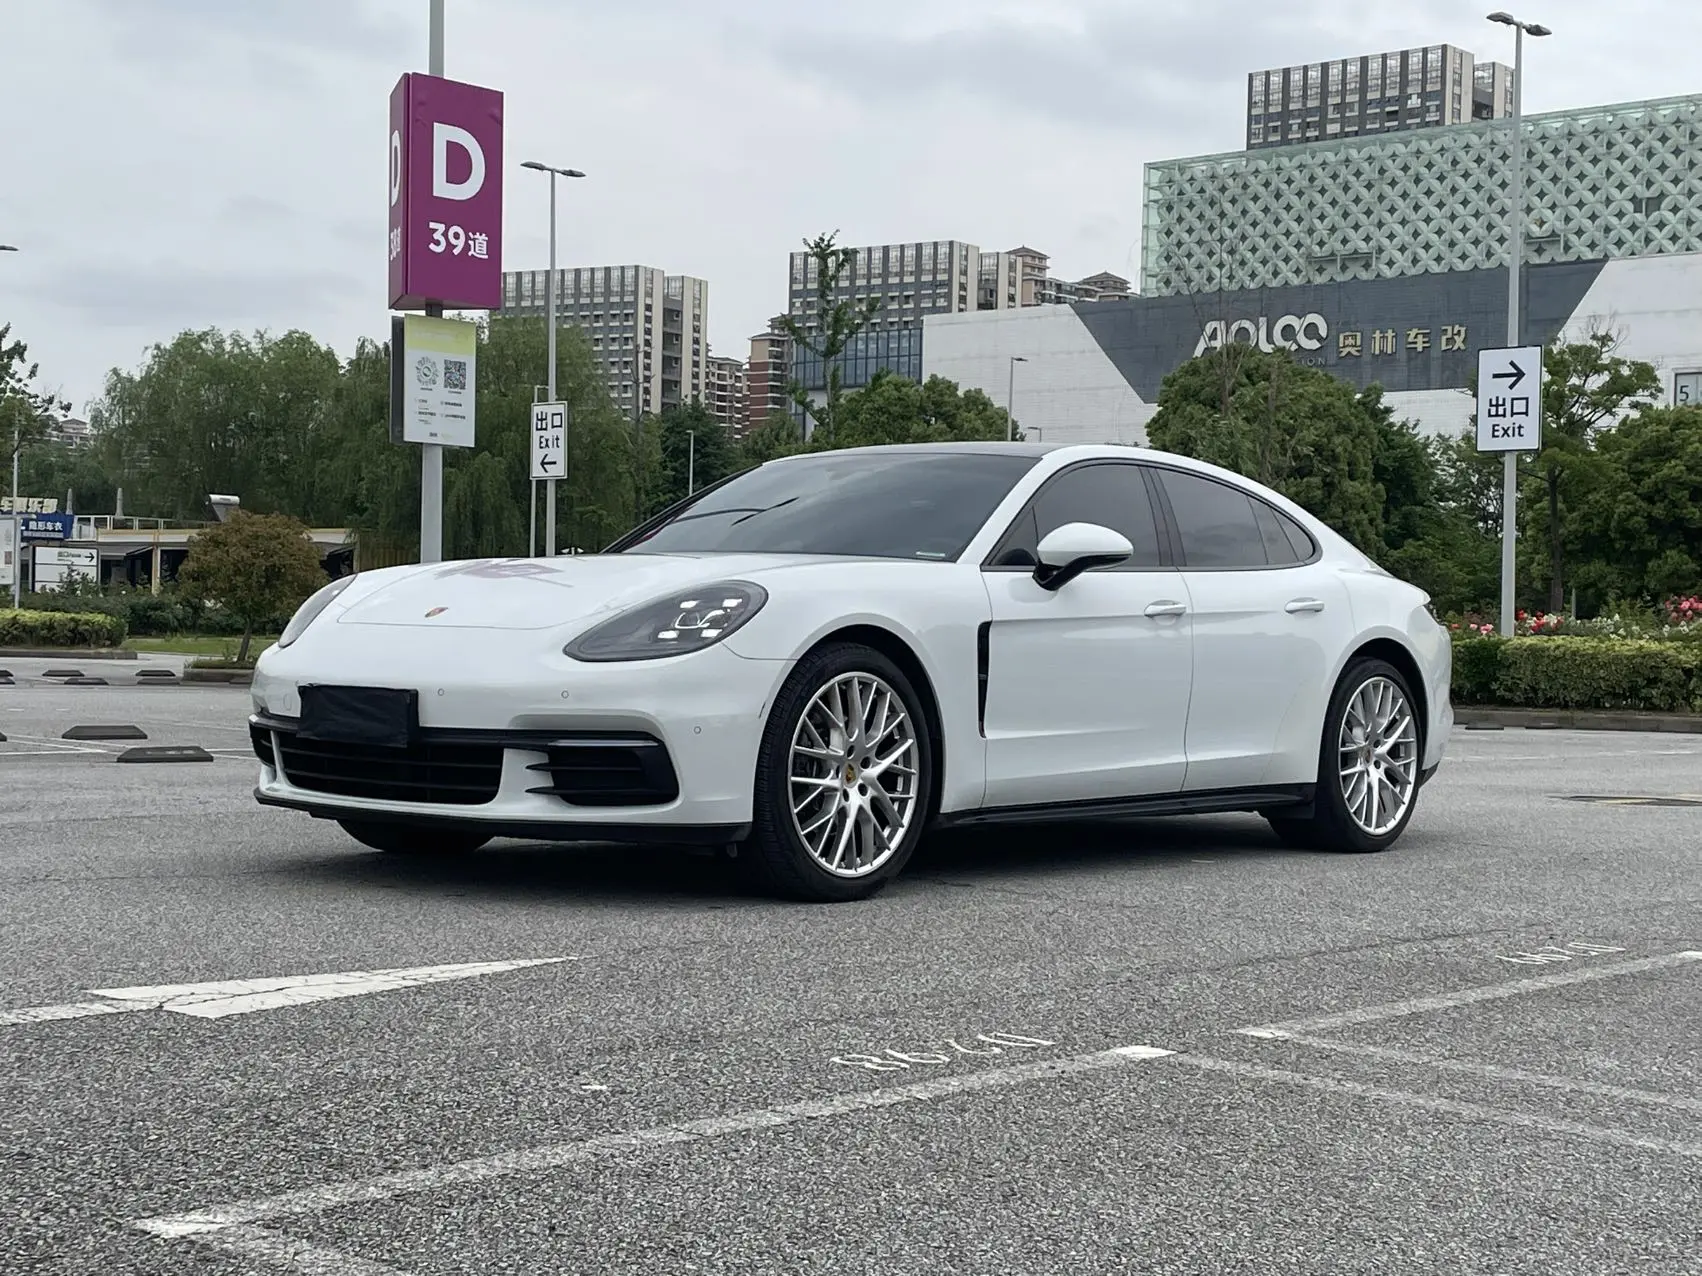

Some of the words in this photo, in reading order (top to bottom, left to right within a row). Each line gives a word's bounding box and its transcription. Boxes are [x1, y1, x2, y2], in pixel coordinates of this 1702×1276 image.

[391, 129, 401, 207] D
[432, 121, 486, 200] D
[428, 221, 489, 259] 39道
[1338, 324, 1467, 357] 奥林车改
[1487, 396, 1530, 418] 出口
[535, 410, 563, 432] 出口
[1491, 422, 1525, 439] Exit
[539, 434, 560, 449] Exit
